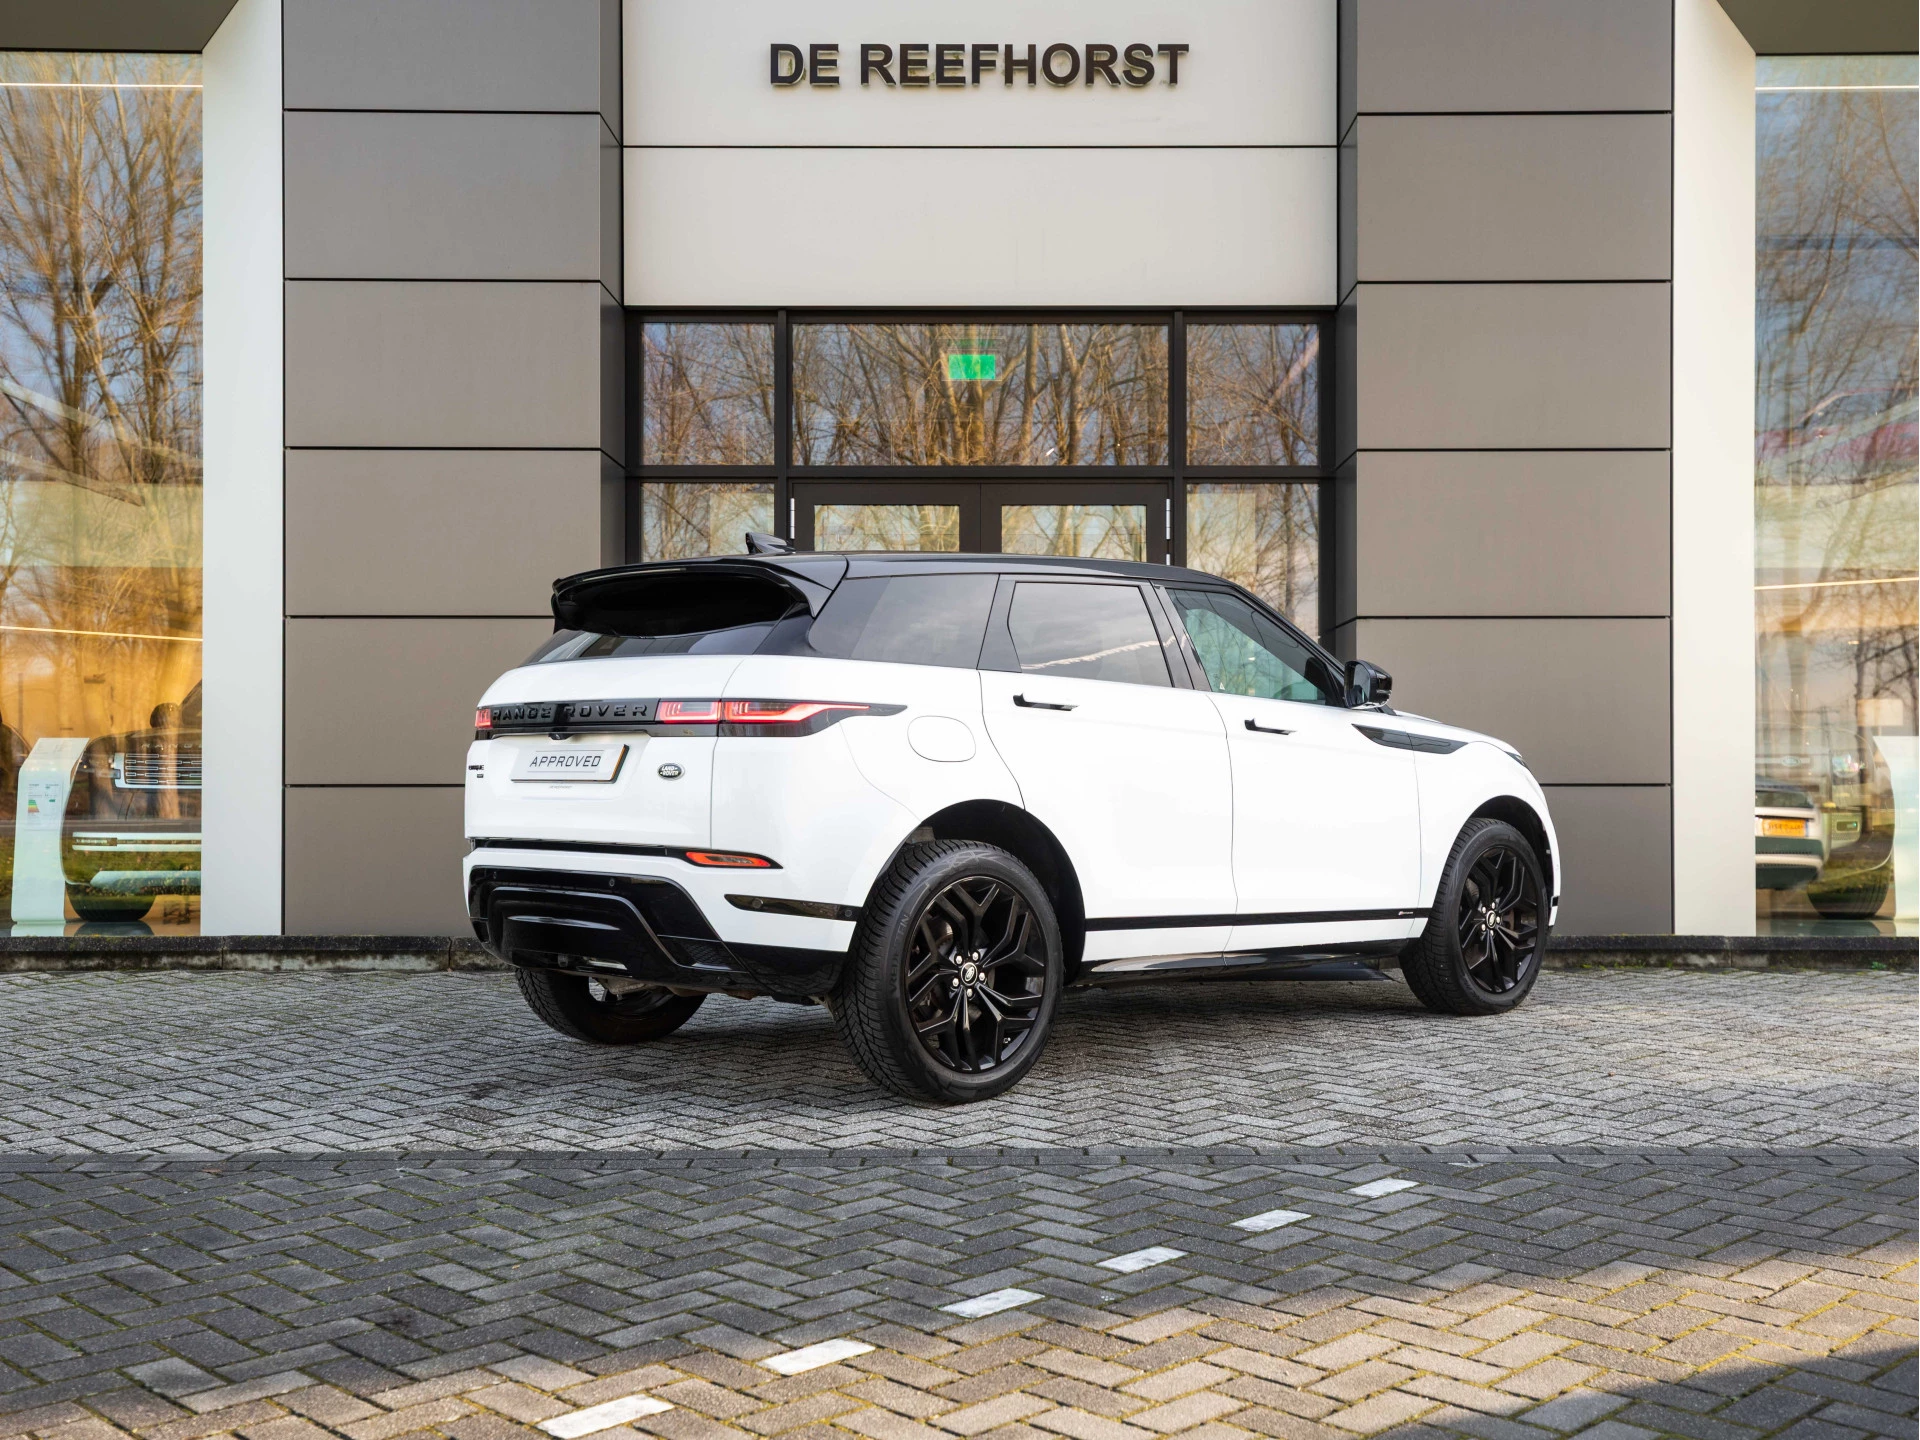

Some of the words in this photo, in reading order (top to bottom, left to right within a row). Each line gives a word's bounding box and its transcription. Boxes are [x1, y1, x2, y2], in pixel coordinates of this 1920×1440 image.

[770, 43, 840, 86] DE
[860, 43, 1189, 87] REEFHORST
[493, 706, 551, 721] RANGE
[563, 703, 648, 718] ROVER
[529, 755, 602, 768] APPROVED
